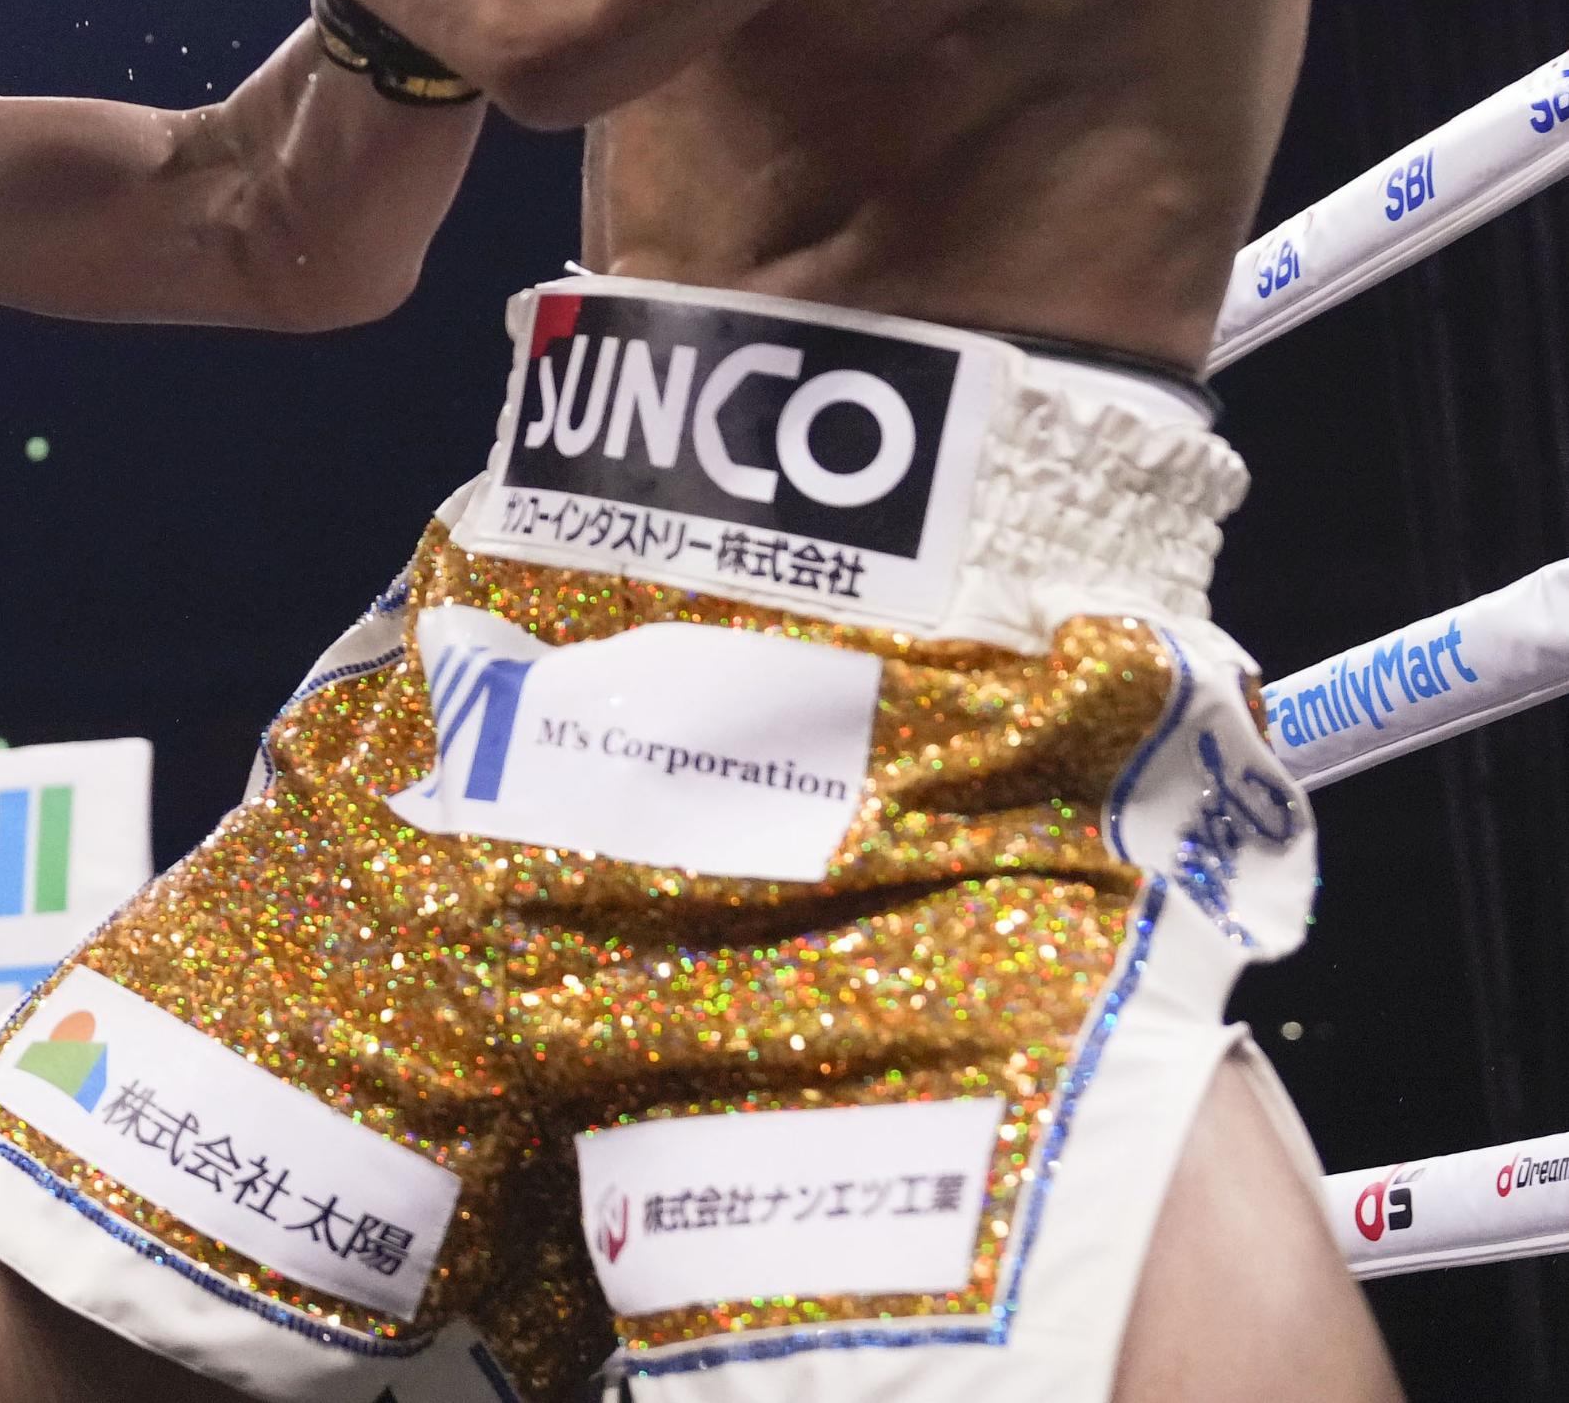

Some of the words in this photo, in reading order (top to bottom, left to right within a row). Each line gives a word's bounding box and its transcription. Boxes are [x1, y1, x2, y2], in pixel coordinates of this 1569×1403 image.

[1385, 147, 1436, 222] SBI
[1257, 240, 1301, 298] SBI
[524, 334, 916, 508] SUNCO
[534, 716, 590, 751] M's
[602, 729, 849, 802] Corporation
[102, 1079, 415, 1277] 株式会社太陽
[643, 1173, 968, 1235] 株式会社ナンエツ工業
